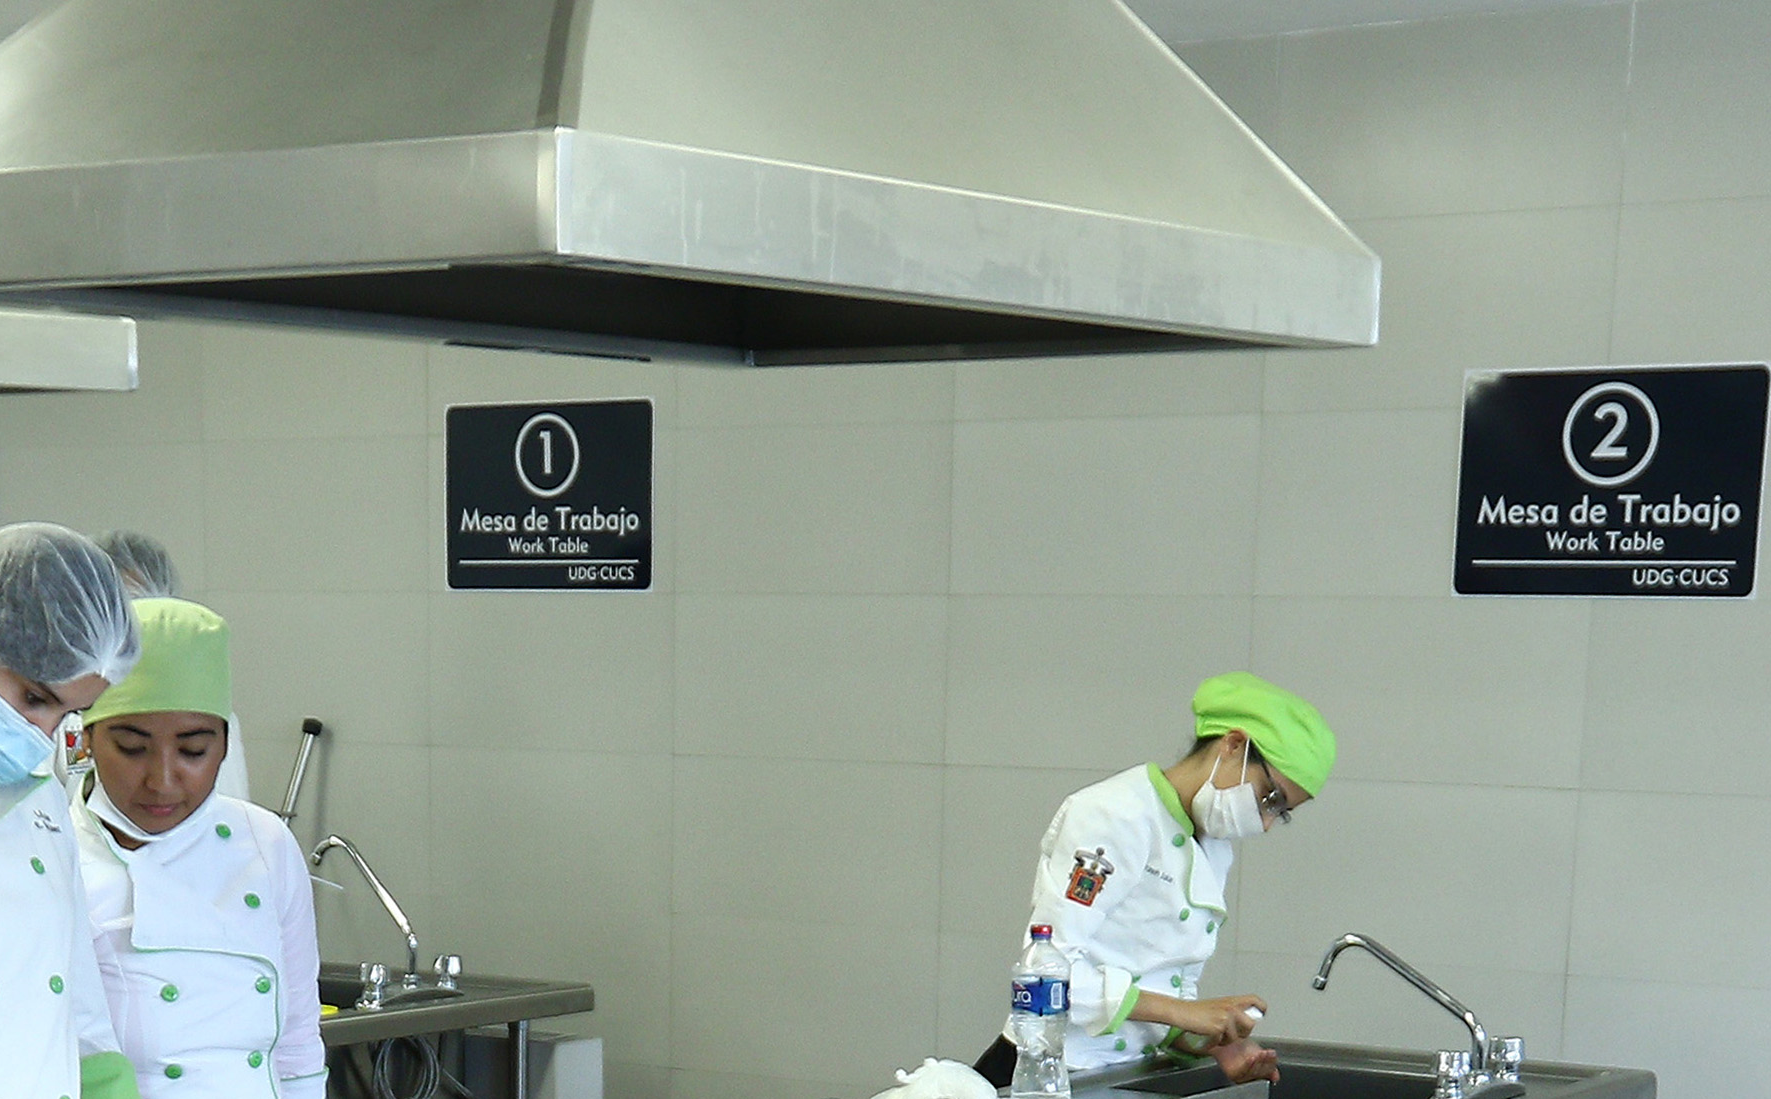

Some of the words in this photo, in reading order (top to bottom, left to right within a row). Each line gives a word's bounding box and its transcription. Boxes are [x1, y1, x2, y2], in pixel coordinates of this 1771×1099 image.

[1590, 402, 1628, 458] 2
[540, 430, 552, 474] 1
[460, 507, 516, 532] Mesa
[523, 506, 549, 532] de
[554, 505, 640, 537] Trabajo
[1477, 495, 1559, 525] Mesa
[1569, 494, 1608, 525] de
[1616, 493, 1741, 532] Trabajo
[507, 536, 545, 554] Work
[548, 536, 590, 554] Table
[1545, 530, 1600, 552] Work
[1605, 530, 1666, 552] Table
